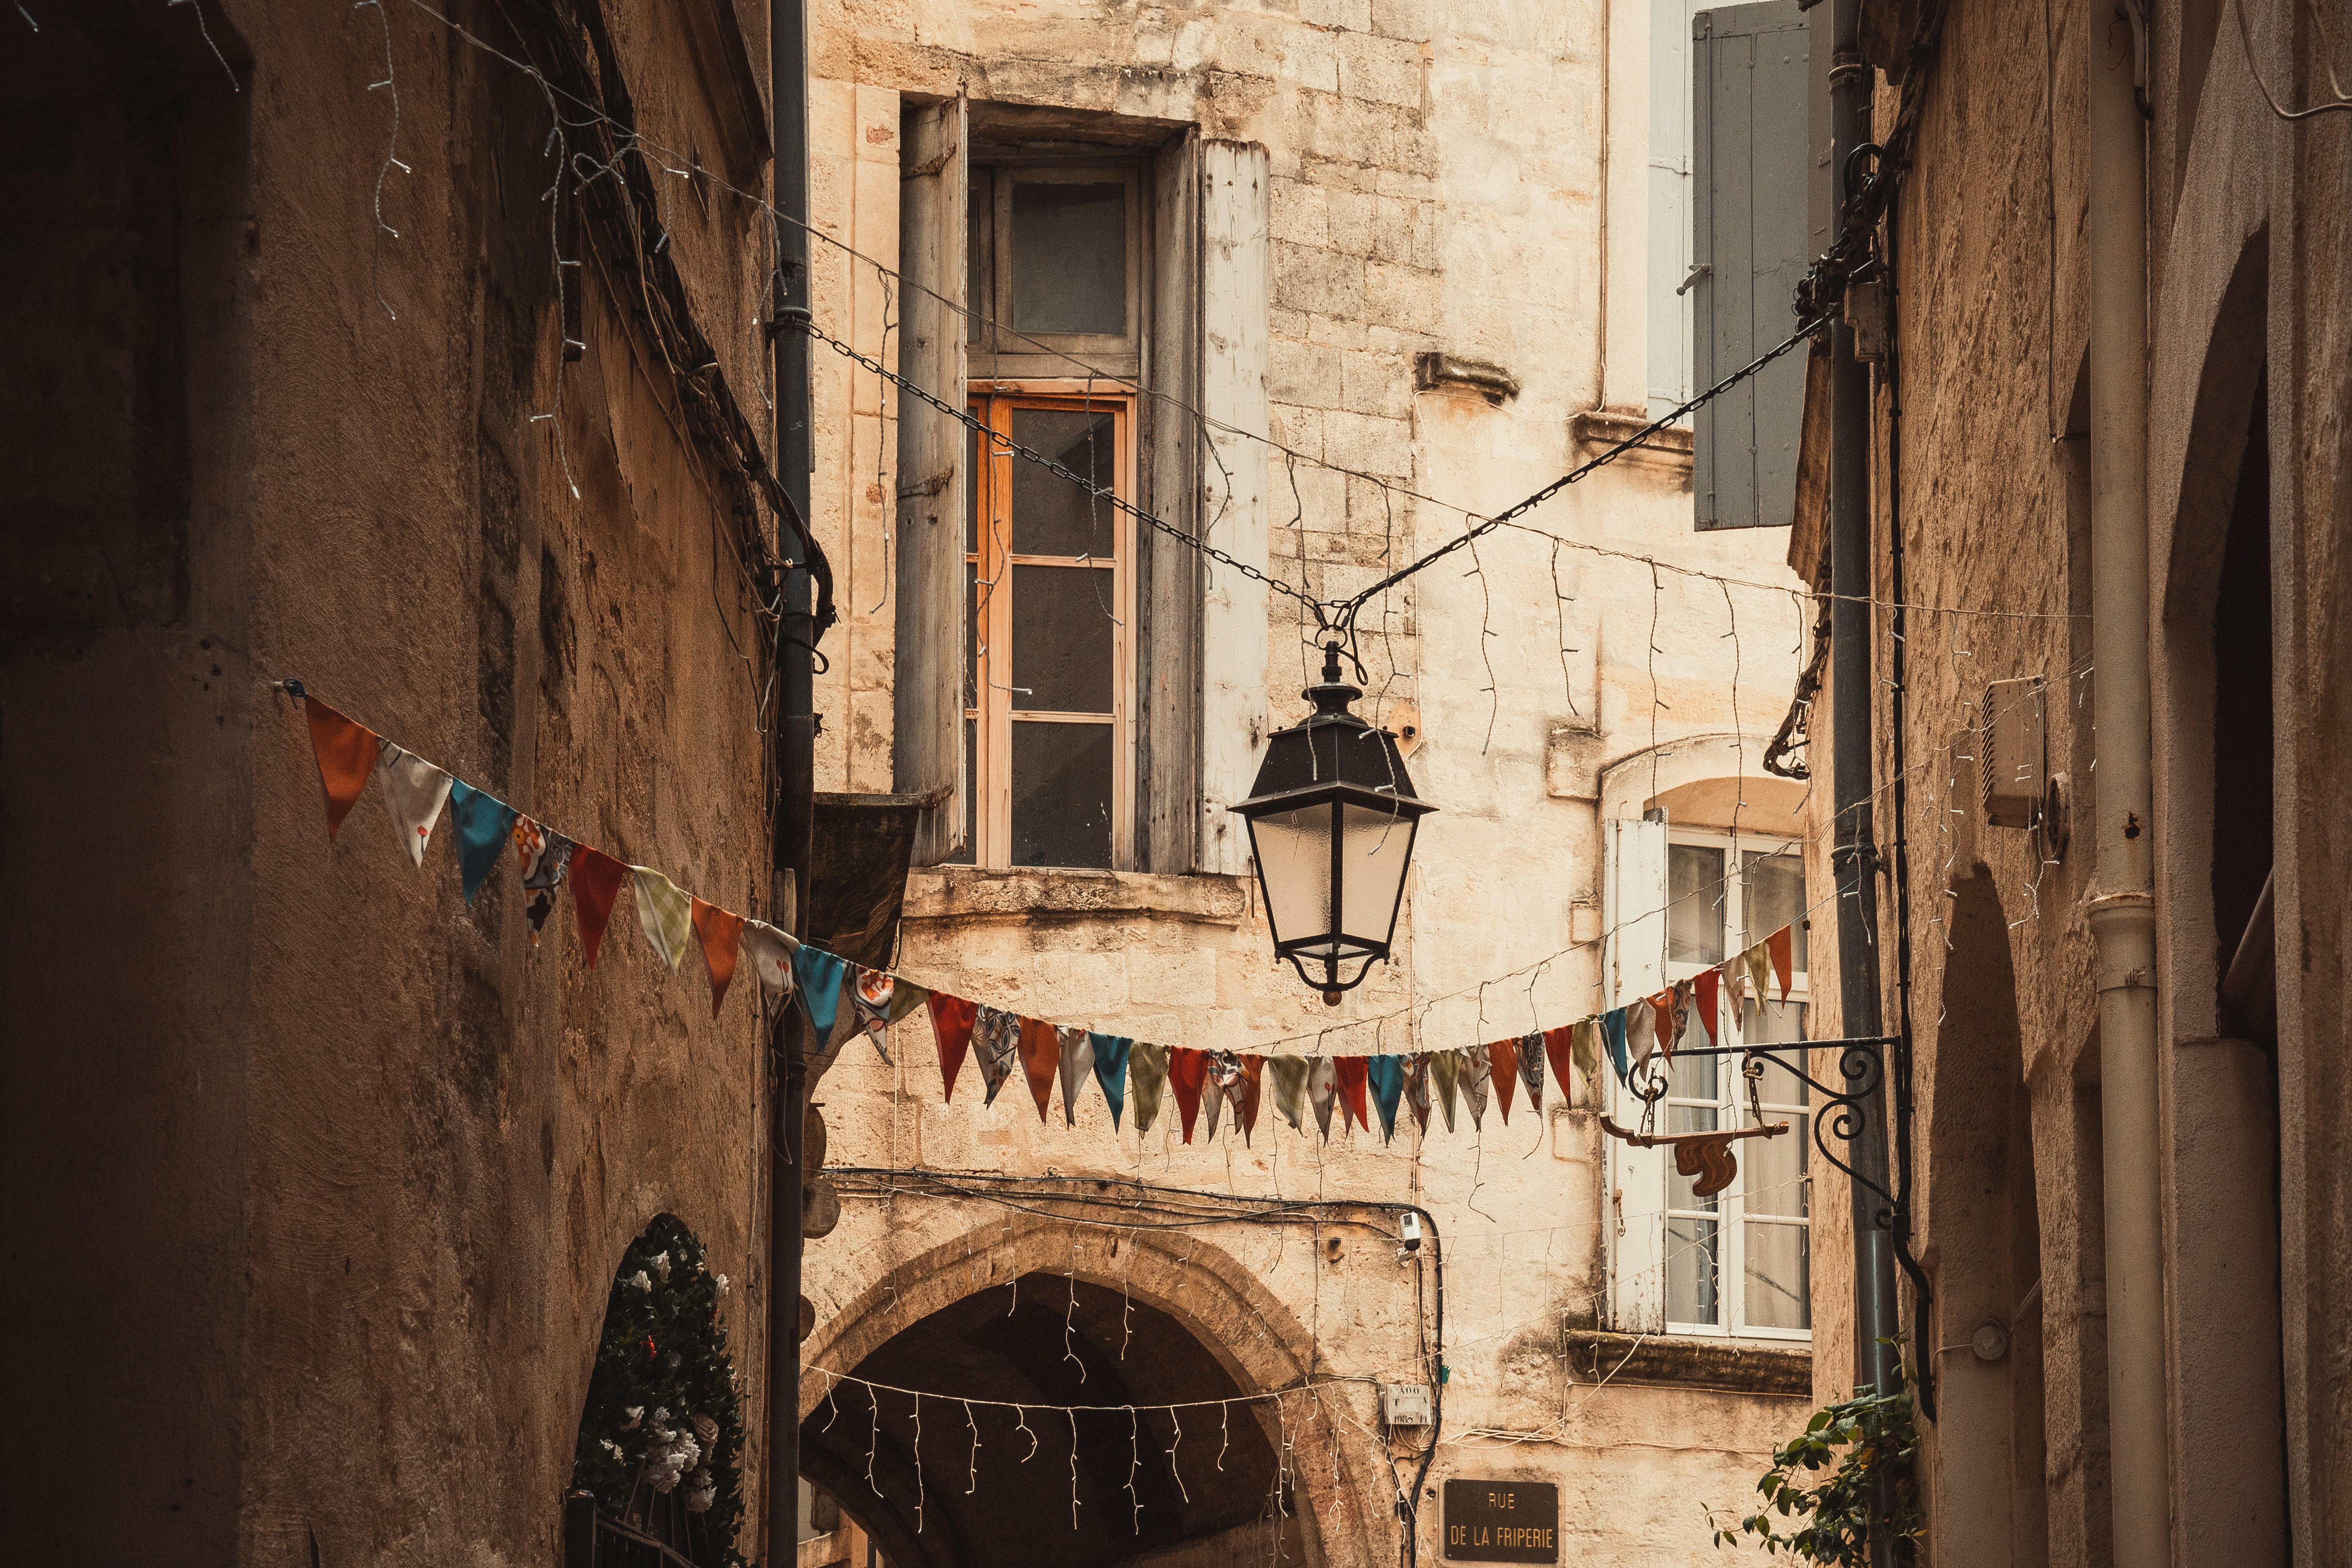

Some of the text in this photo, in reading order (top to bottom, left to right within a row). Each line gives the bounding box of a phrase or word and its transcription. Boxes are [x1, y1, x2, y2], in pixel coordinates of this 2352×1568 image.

[1489, 1493, 1514, 1509] RUE
[1451, 1525, 1553, 1548] DE LA FRIPERIE
